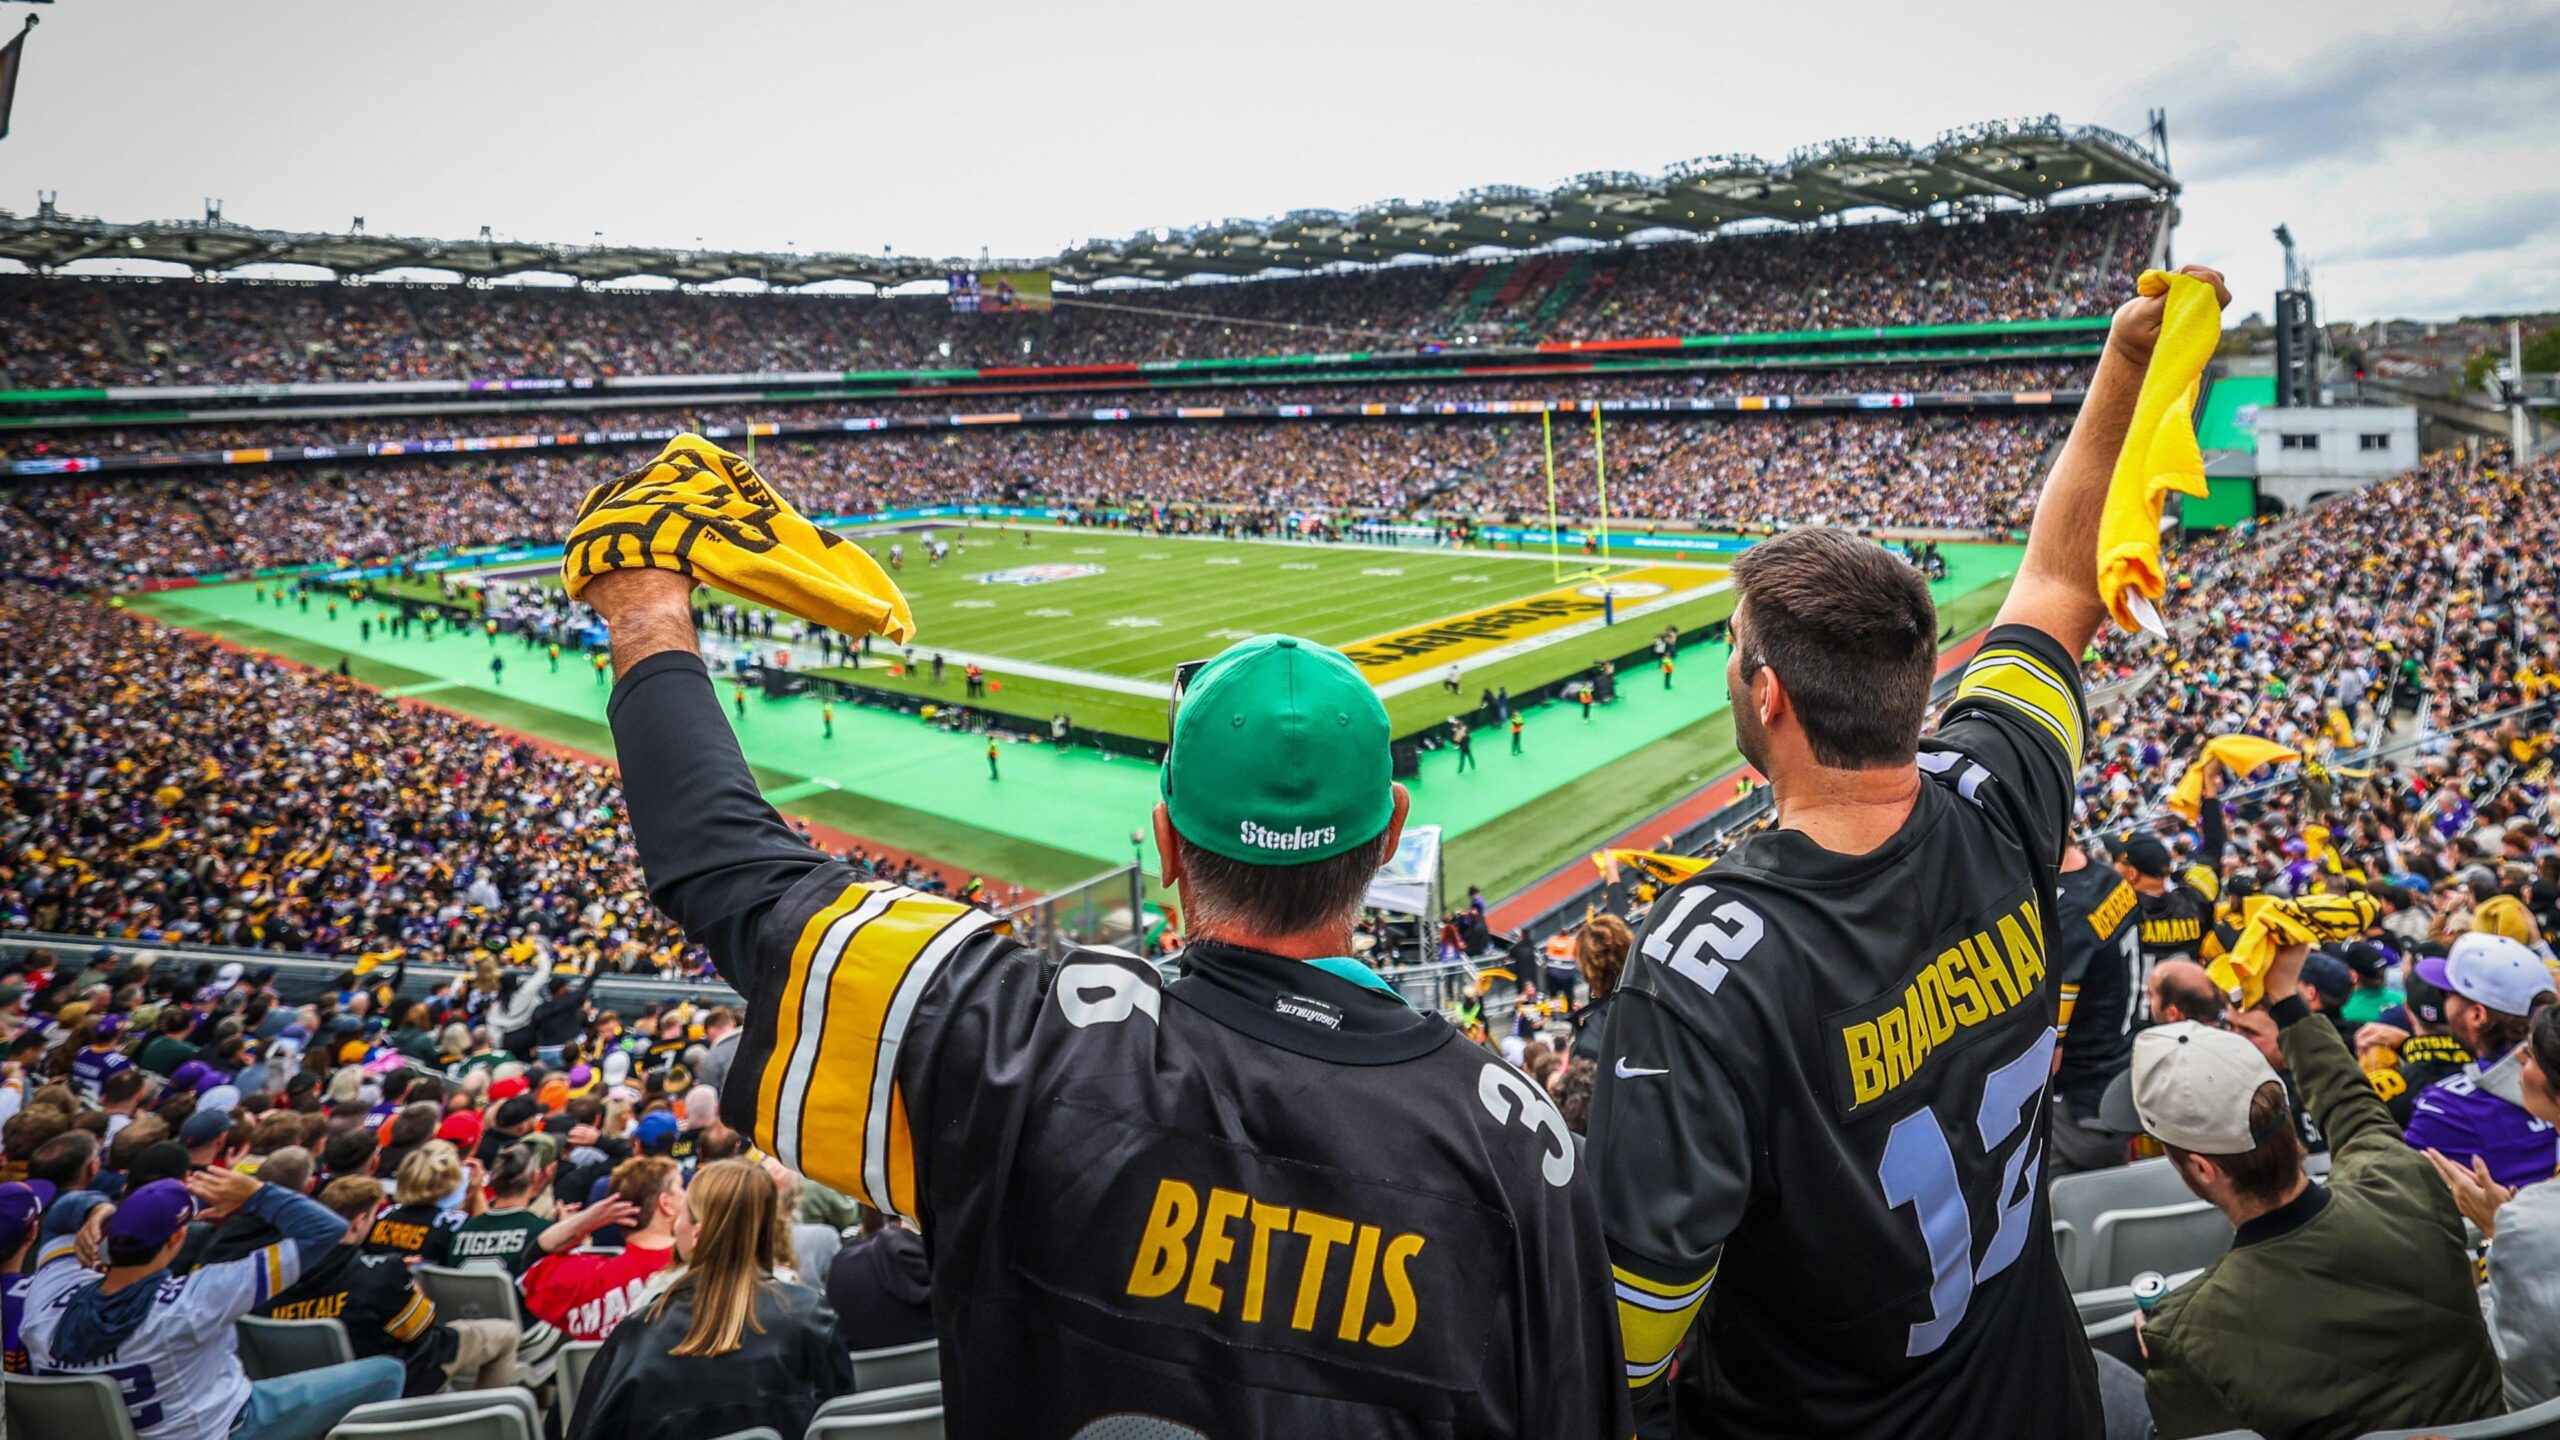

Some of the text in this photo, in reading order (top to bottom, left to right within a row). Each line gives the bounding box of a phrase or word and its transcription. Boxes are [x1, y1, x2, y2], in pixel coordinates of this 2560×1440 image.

[732, 461, 775, 509] OFF
[704, 530, 722, 543] TM
[1240, 820, 1335, 850] Steelers
[1641, 885, 1764, 995] 12
[2141, 918, 2202, 943] AMALU
[1057, 944, 1163, 1028] 6
[1478, 1062, 1575, 1187] 3
[1877, 1025, 2058, 1358] 12
[452, 1228, 529, 1257] TIGERS
[1125, 1177, 1426, 1348] BETTIS
[272, 1291, 349, 1320] METCALF
